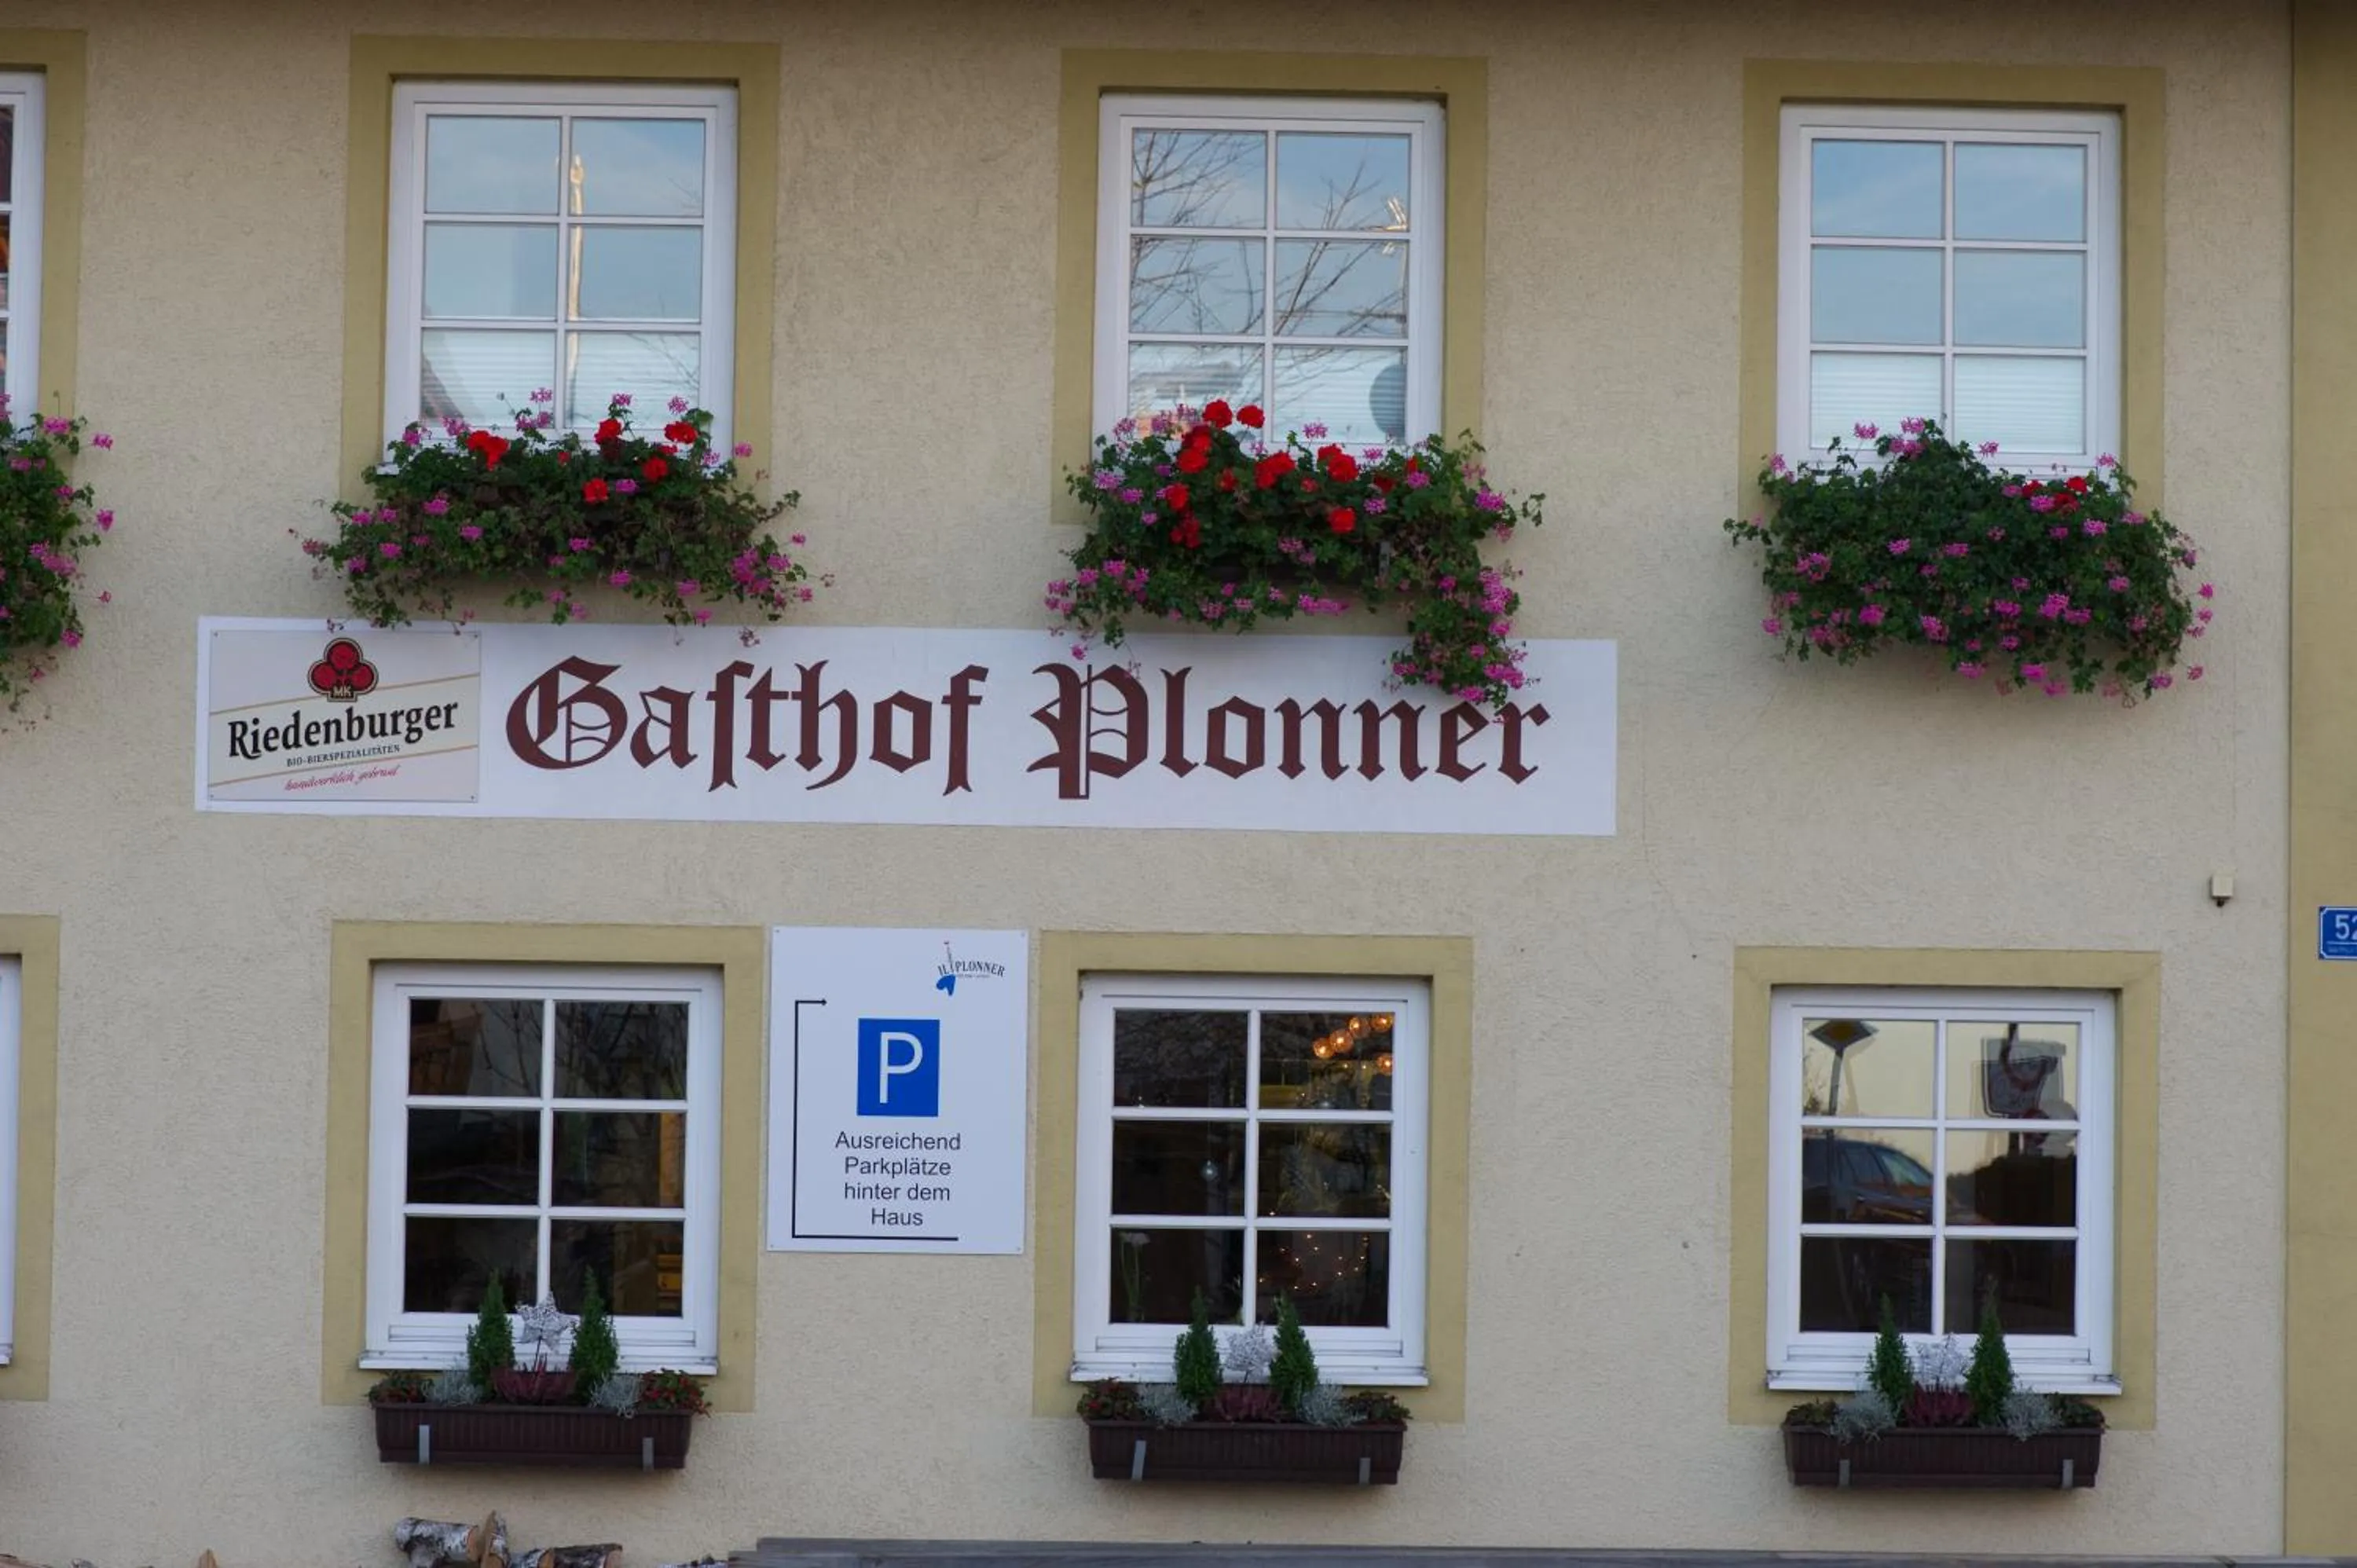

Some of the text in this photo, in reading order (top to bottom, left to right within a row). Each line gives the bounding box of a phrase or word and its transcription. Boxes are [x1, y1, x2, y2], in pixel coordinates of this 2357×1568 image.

[333, 684, 352, 698] MK
[228, 702, 458, 760] Riedenburger
[1026, 662, 1551, 800] Plonner
[955, 961, 1005, 977] PLONNER
[879, 1031, 923, 1104] P
[835, 1130, 961, 1150] Ausreichend
[845, 1156, 951, 1179] Parkplätze
[845, 1182, 951, 1201] hinter dem
[871, 1207, 923, 1226] Haus
